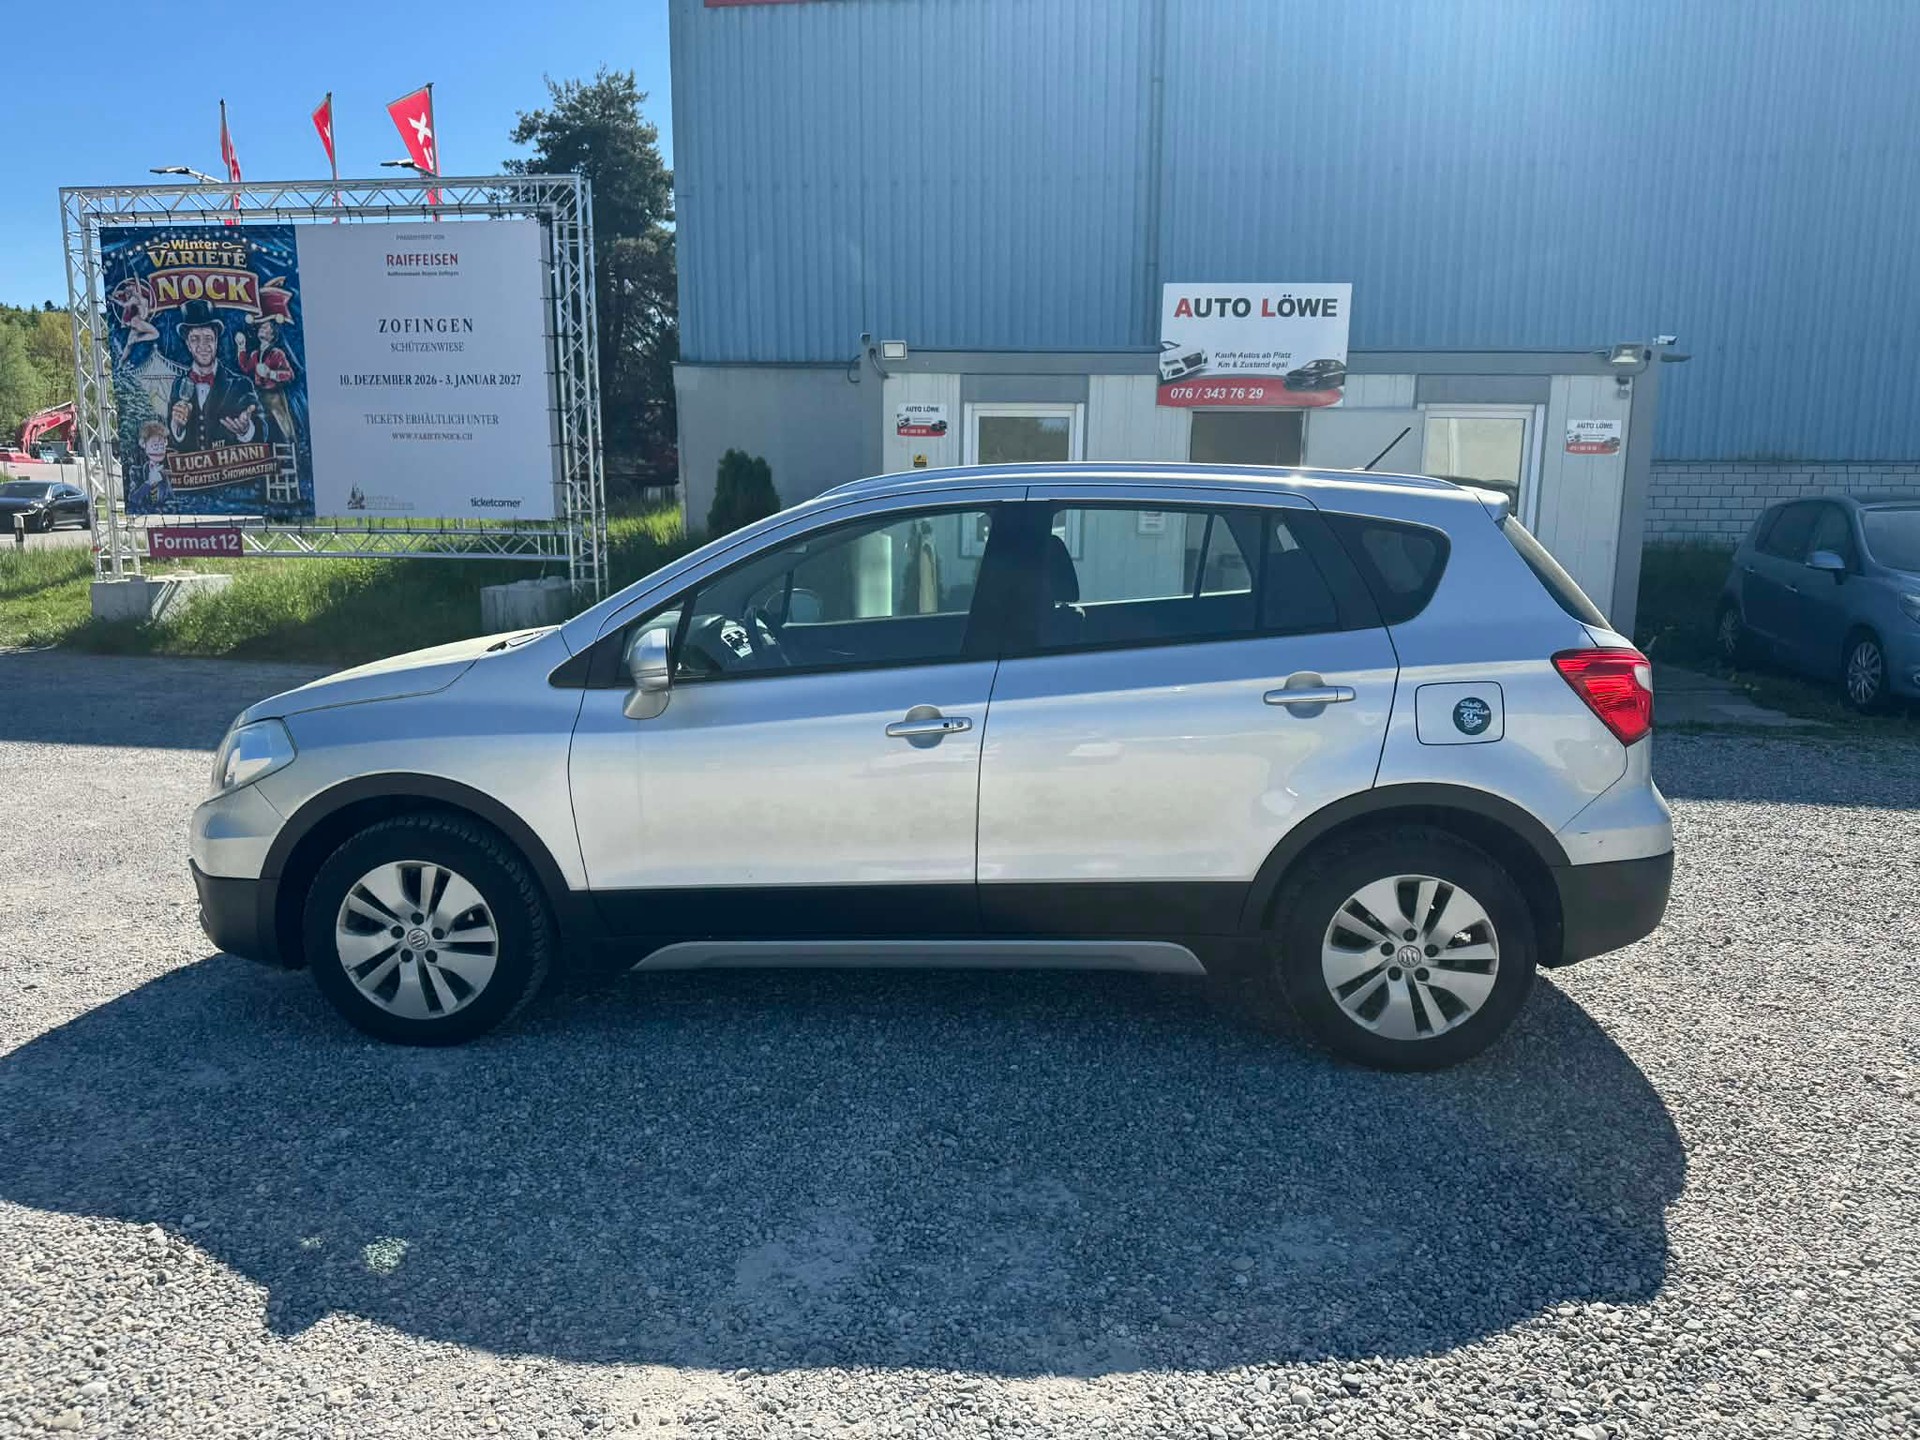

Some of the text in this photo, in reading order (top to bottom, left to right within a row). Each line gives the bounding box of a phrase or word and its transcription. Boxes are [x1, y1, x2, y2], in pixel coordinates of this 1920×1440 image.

[170, 239, 219, 250] Winter
[386, 253, 459, 266] RAIFFEISEN
[156, 275, 252, 302] NOCK
[1174, 294, 1338, 318] AUTO LÖWE
[378, 318, 474, 333] ZOFINGEN
[390, 340, 465, 352] SCHÜTZENWIESE
[1215, 351, 1292, 359] Kaufe Autos ab Platz
[1217, 361, 1230, 369] Km
[1239, 361, 1270, 369] Zustand
[339, 374, 352, 386] 10.
[354, 374, 413, 386] DEZEMBER
[414, 374, 437, 386] 2026
[445, 374, 453, 386] 3.
[454, 374, 497, 388] JANUAR
[499, 374, 521, 386] 2027
[1170, 387, 1193, 400] 076
[1195, 388, 1202, 400] /
[1204, 387, 1226, 400] 343
[1249, 387, 1264, 400] 29
[364, 411, 499, 425] TICKETS ERHÄLTLICH UNTER
[212, 440, 225, 449] MIT
[175, 445, 265, 472] LUCA HÄNNI
[183, 472, 221, 486] GREATEST
[471, 497, 522, 508] ticketcorner
